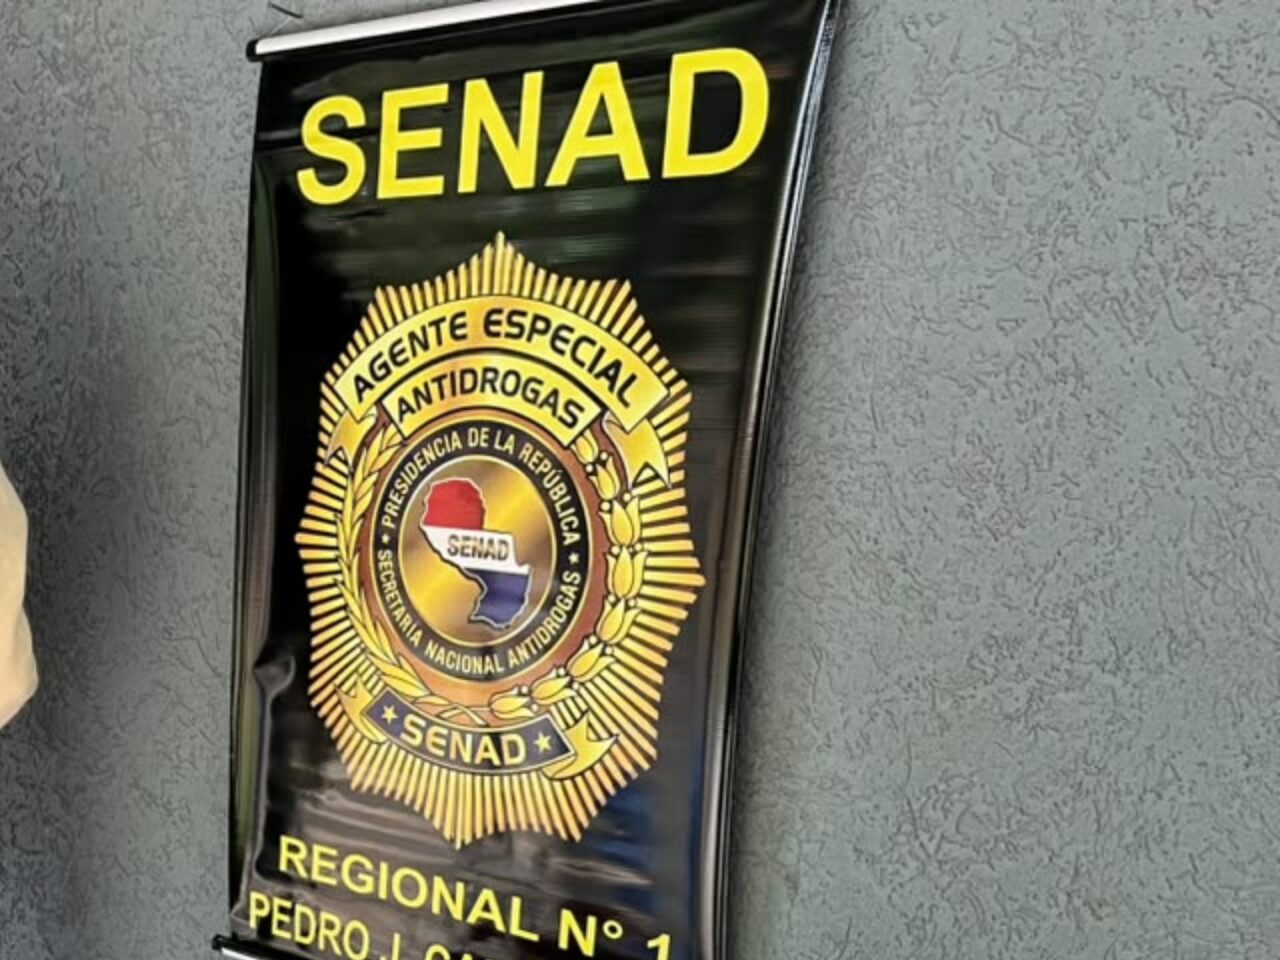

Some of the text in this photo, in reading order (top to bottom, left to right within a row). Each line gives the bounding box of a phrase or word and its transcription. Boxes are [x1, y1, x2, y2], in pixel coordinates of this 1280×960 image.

[296, 47, 770, 204] SENAD
[352, 308, 638, 408] AGENTE ESPECIAL
[396, 367, 585, 429] ANTIDROGAS
[381, 428, 581, 546] PRESIDENCIA DE LA REPÚBLICA
[447, 534, 510, 561] SENAD
[424, 640, 505, 673] NACIONAL
[508, 570, 581, 669] ANTIDROGAS
[400, 714, 527, 766] SENAD
[278, 835, 539, 943] REGIONAL
[558, 908, 624, 958] N°
